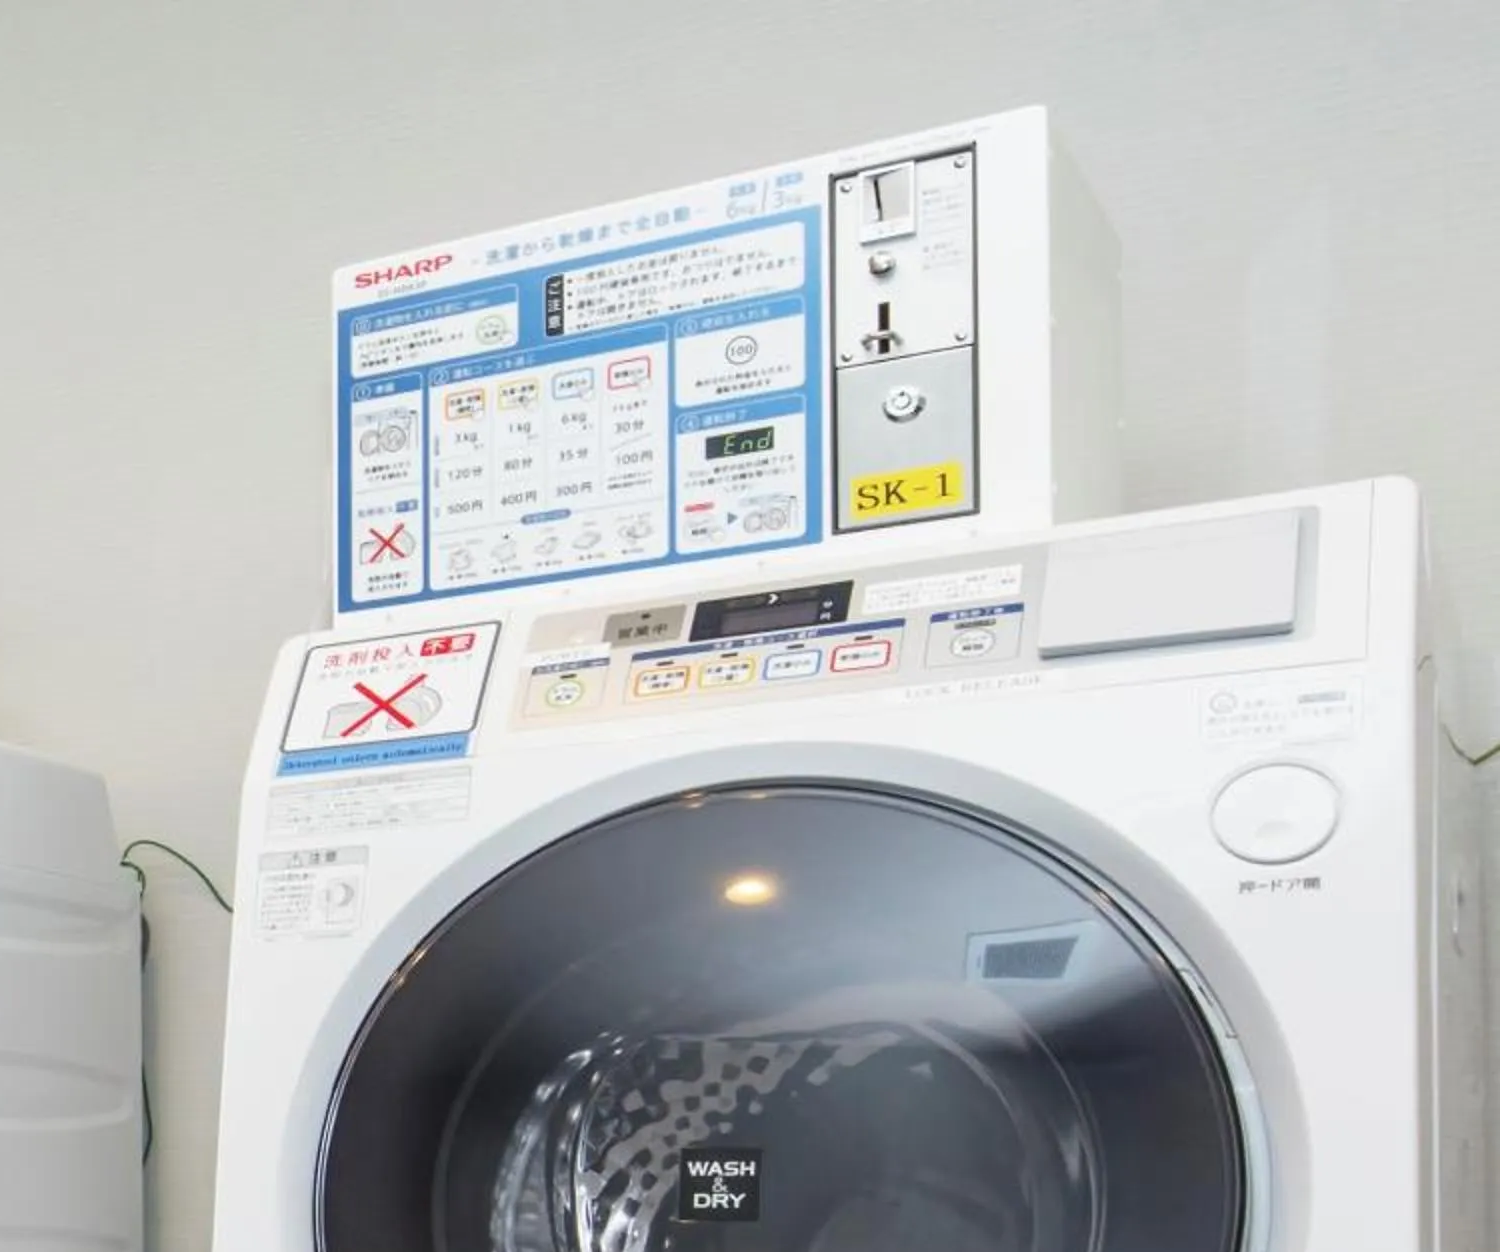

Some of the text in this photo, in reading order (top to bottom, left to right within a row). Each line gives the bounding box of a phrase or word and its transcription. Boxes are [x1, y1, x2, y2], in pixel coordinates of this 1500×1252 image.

[355, 254, 453, 288] SHARP
[722, 434, 773, 456] End
[856, 473, 955, 512] SK-1
[687, 1160, 757, 1177] WASH
[711, 1176, 728, 1193] &
[693, 1193, 747, 1209] DRY
